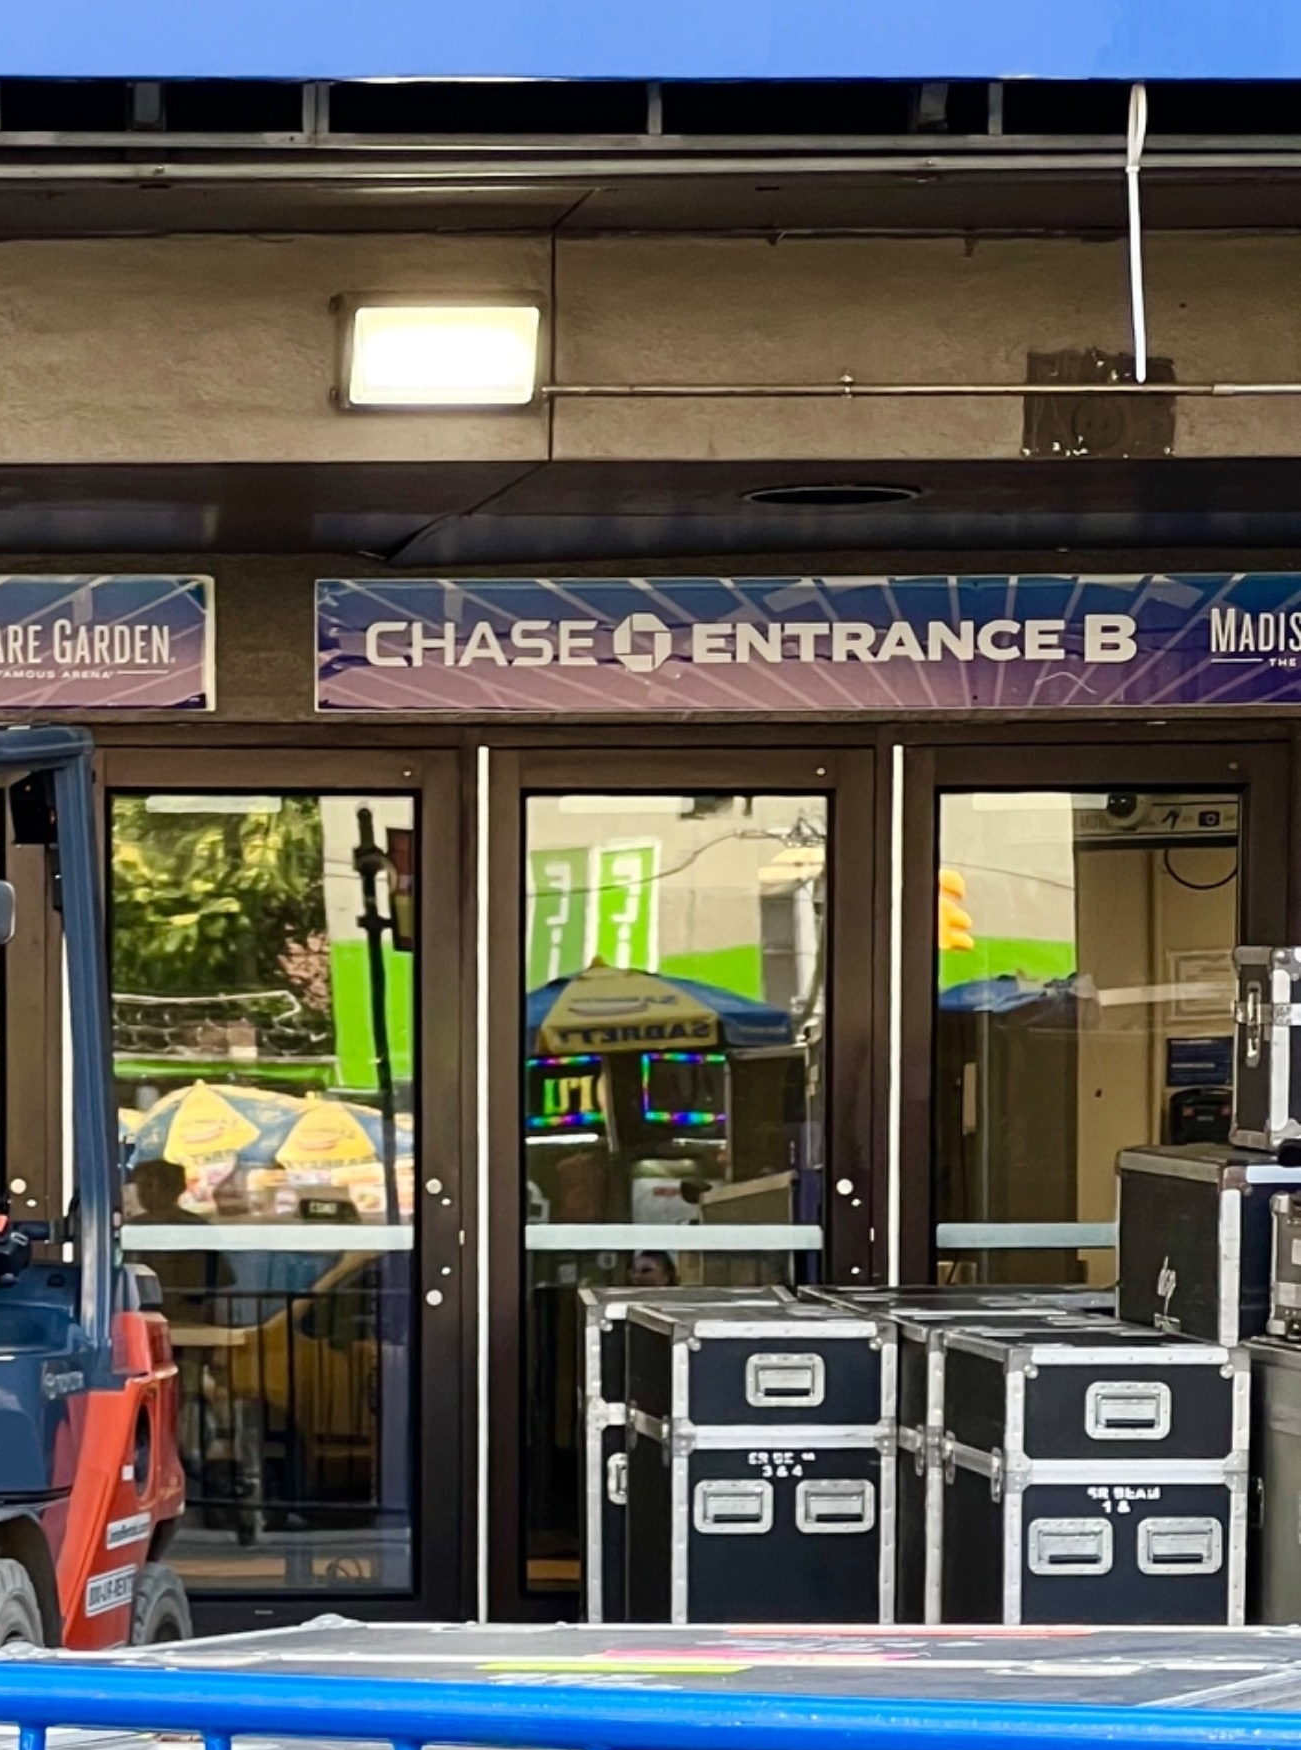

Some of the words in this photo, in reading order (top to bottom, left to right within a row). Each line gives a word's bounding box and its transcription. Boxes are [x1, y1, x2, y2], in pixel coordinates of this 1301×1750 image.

[366, 620, 599, 667] CHASE
[692, 618, 1066, 663] ENTRANCE
[1084, 613, 1138, 664] B
[1268, 658, 1297, 668] THE
